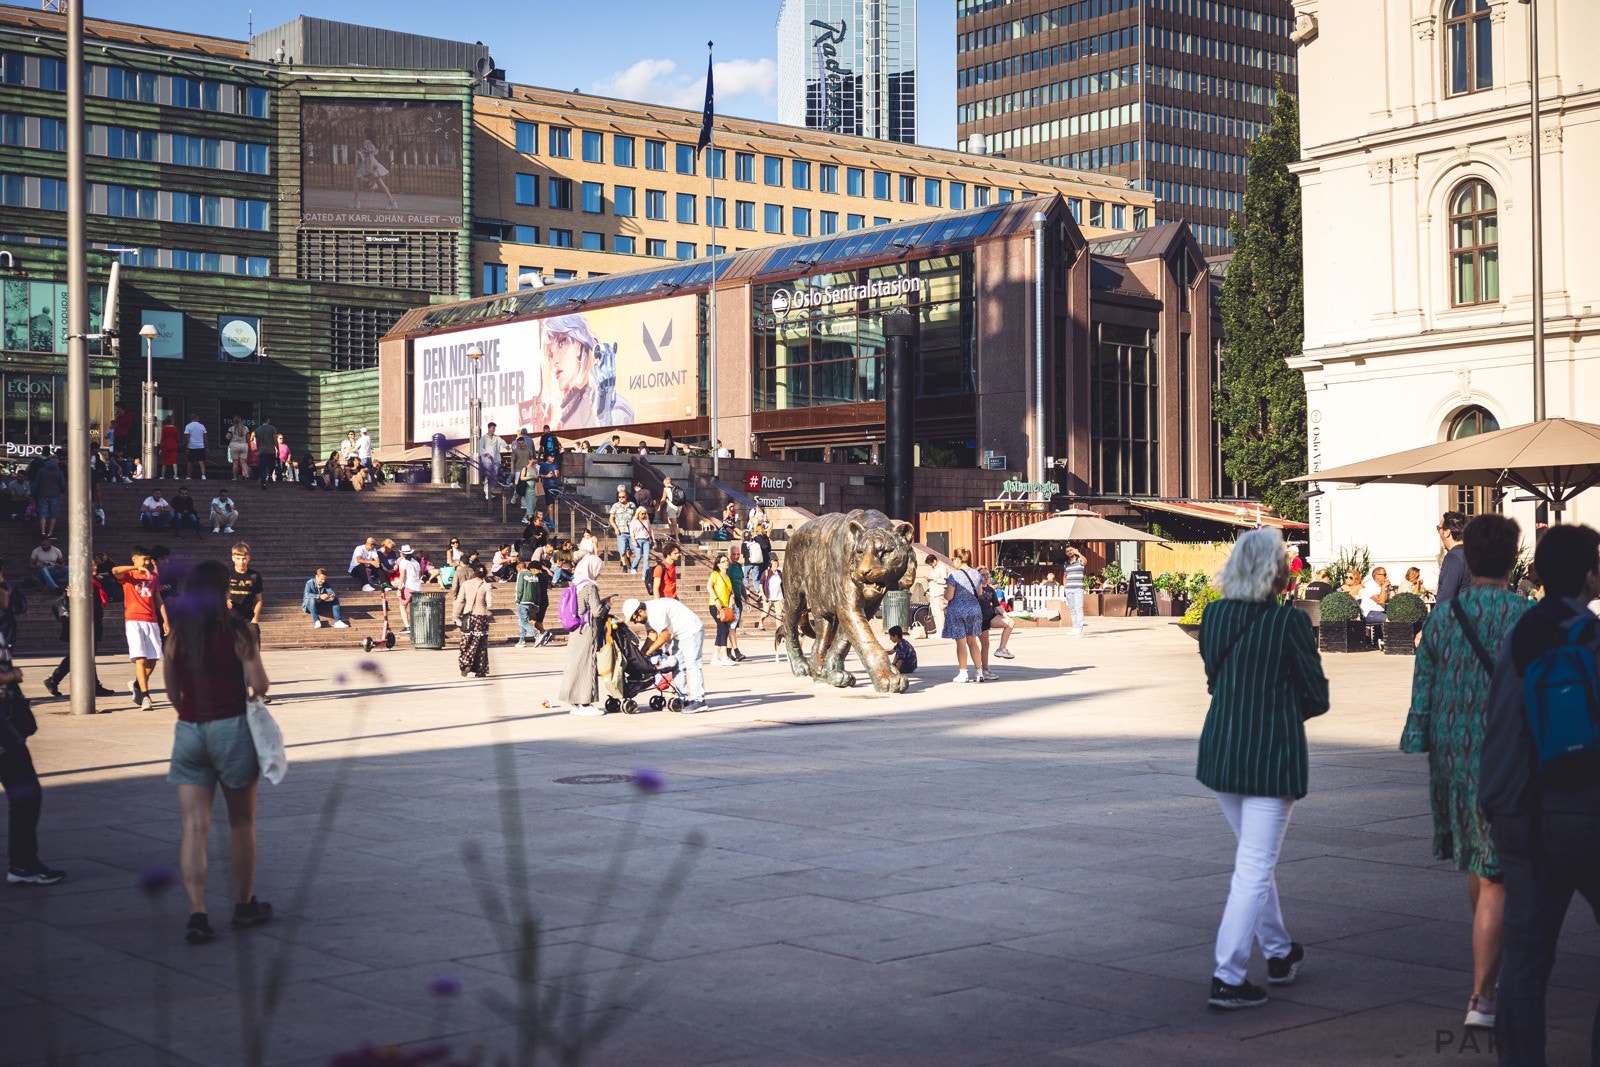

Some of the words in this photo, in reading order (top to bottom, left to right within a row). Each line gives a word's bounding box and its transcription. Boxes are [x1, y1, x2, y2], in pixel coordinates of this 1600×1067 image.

[335, 213, 347, 222] AT
[349, 213, 372, 222] KARL
[373, 214, 406, 223] JOHAN.
[408, 215, 441, 224] PALEET
[793, 287, 822, 308] Oslo
[824, 274, 920, 305] Sentralstasjon
[423, 346, 447, 381] DEN
[7, 381, 52, 395] EGON
[629, 369, 688, 390] VALORANT
[480, 374, 496, 408] ER
[499, 370, 525, 407] HER
[449, 416, 469, 426] GRAT
[761, 476, 786, 489] Ruter
[786, 476, 793, 489] S
